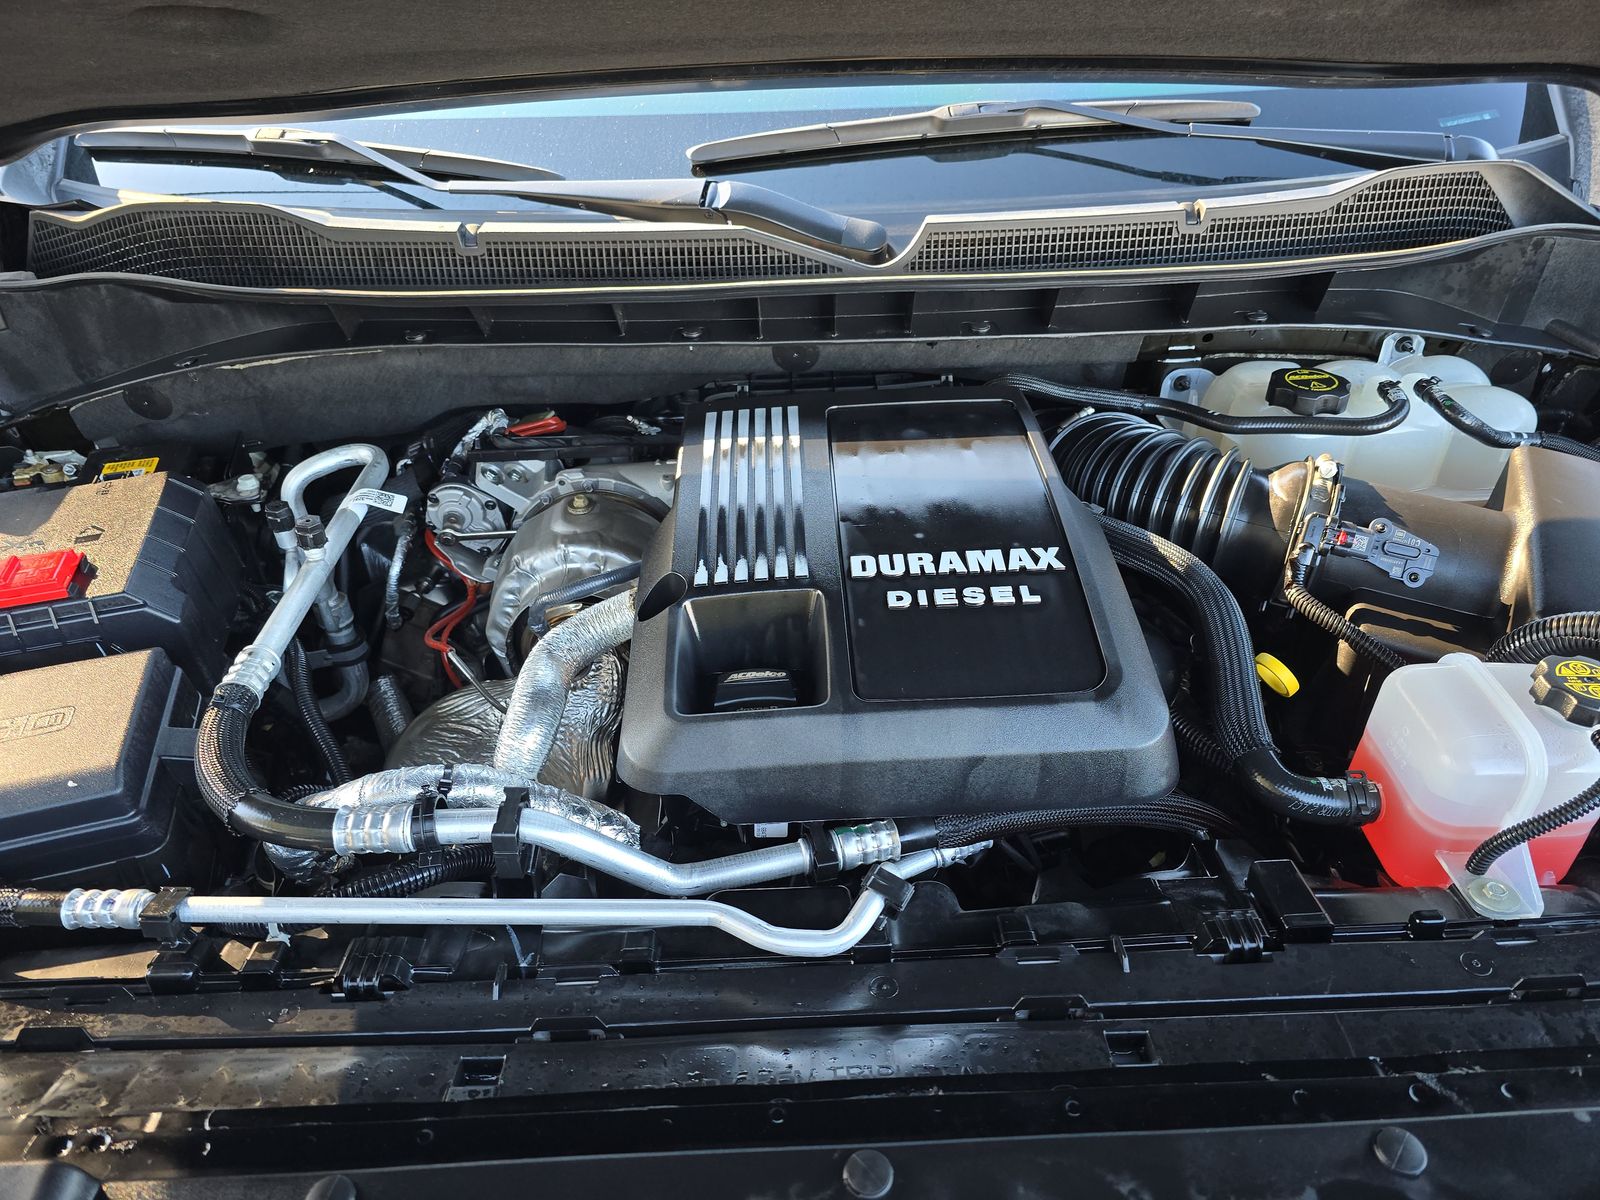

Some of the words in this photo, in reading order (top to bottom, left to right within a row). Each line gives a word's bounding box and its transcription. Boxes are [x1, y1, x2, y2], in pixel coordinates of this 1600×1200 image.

[850, 547, 1066, 578] DURAMAX
[886, 585, 1042, 609] DIESEL
[724, 670, 787, 682] ACDelco
